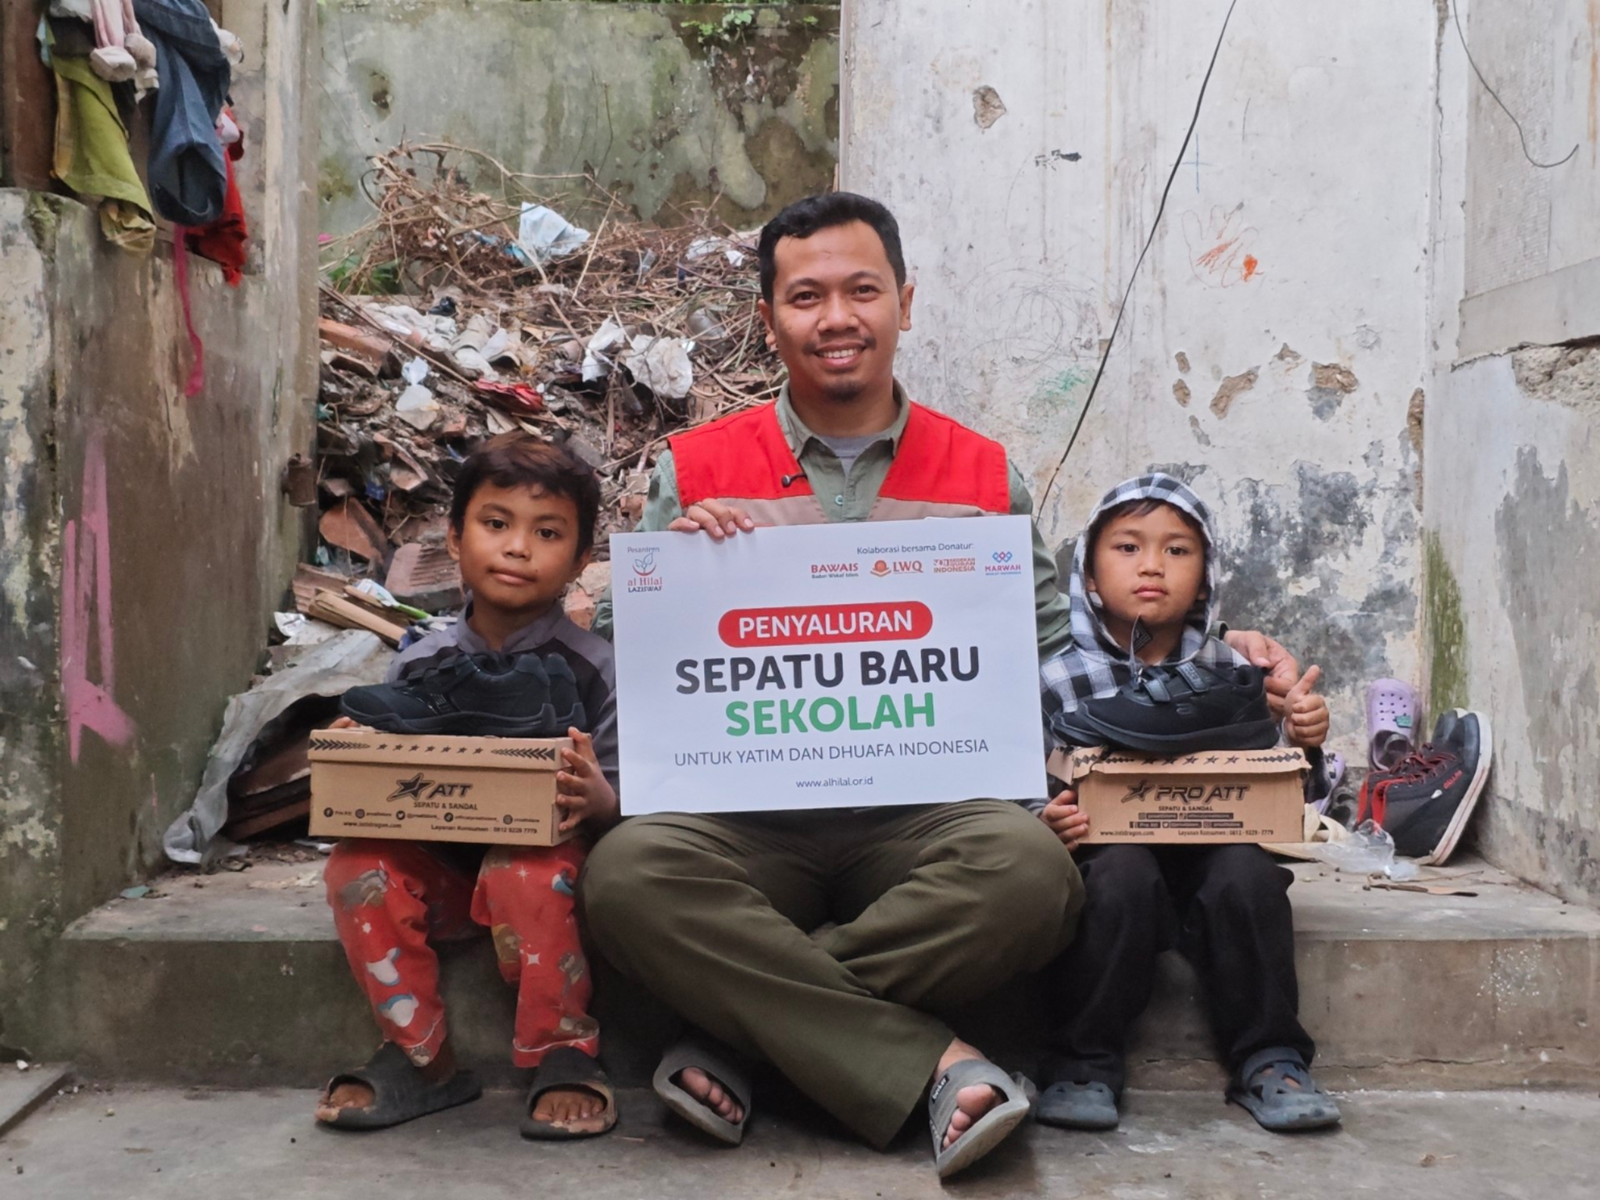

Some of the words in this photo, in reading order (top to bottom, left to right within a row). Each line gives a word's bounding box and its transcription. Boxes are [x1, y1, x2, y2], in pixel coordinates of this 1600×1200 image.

[857, 546, 899, 554] Kolaborasi
[901, 545, 936, 553] bersama
[811, 563, 858, 573] BAWAIS
[893, 560, 924, 573] LWQ
[628, 577, 636, 586] al
[640, 577, 662, 586] Hilal
[739, 610, 912, 639] PENYALURAN
[676, 652, 844, 694] SEPATU
[860, 646, 979, 685] BARU
[725, 692, 935, 736] SEKOLAH
[674, 751, 732, 766] UNTUK
[737, 748, 784, 764] YATIM
[789, 746, 823, 762] DAN
[829, 743, 895, 760] DHUAFA
[899, 739, 989, 756] INDONESIA
[426, 782, 473, 800] ATT
[796, 776, 874, 788] www.alhilal.or.id
[1154, 784, 1205, 804] PRO
[1202, 783, 1250, 804] ATT
